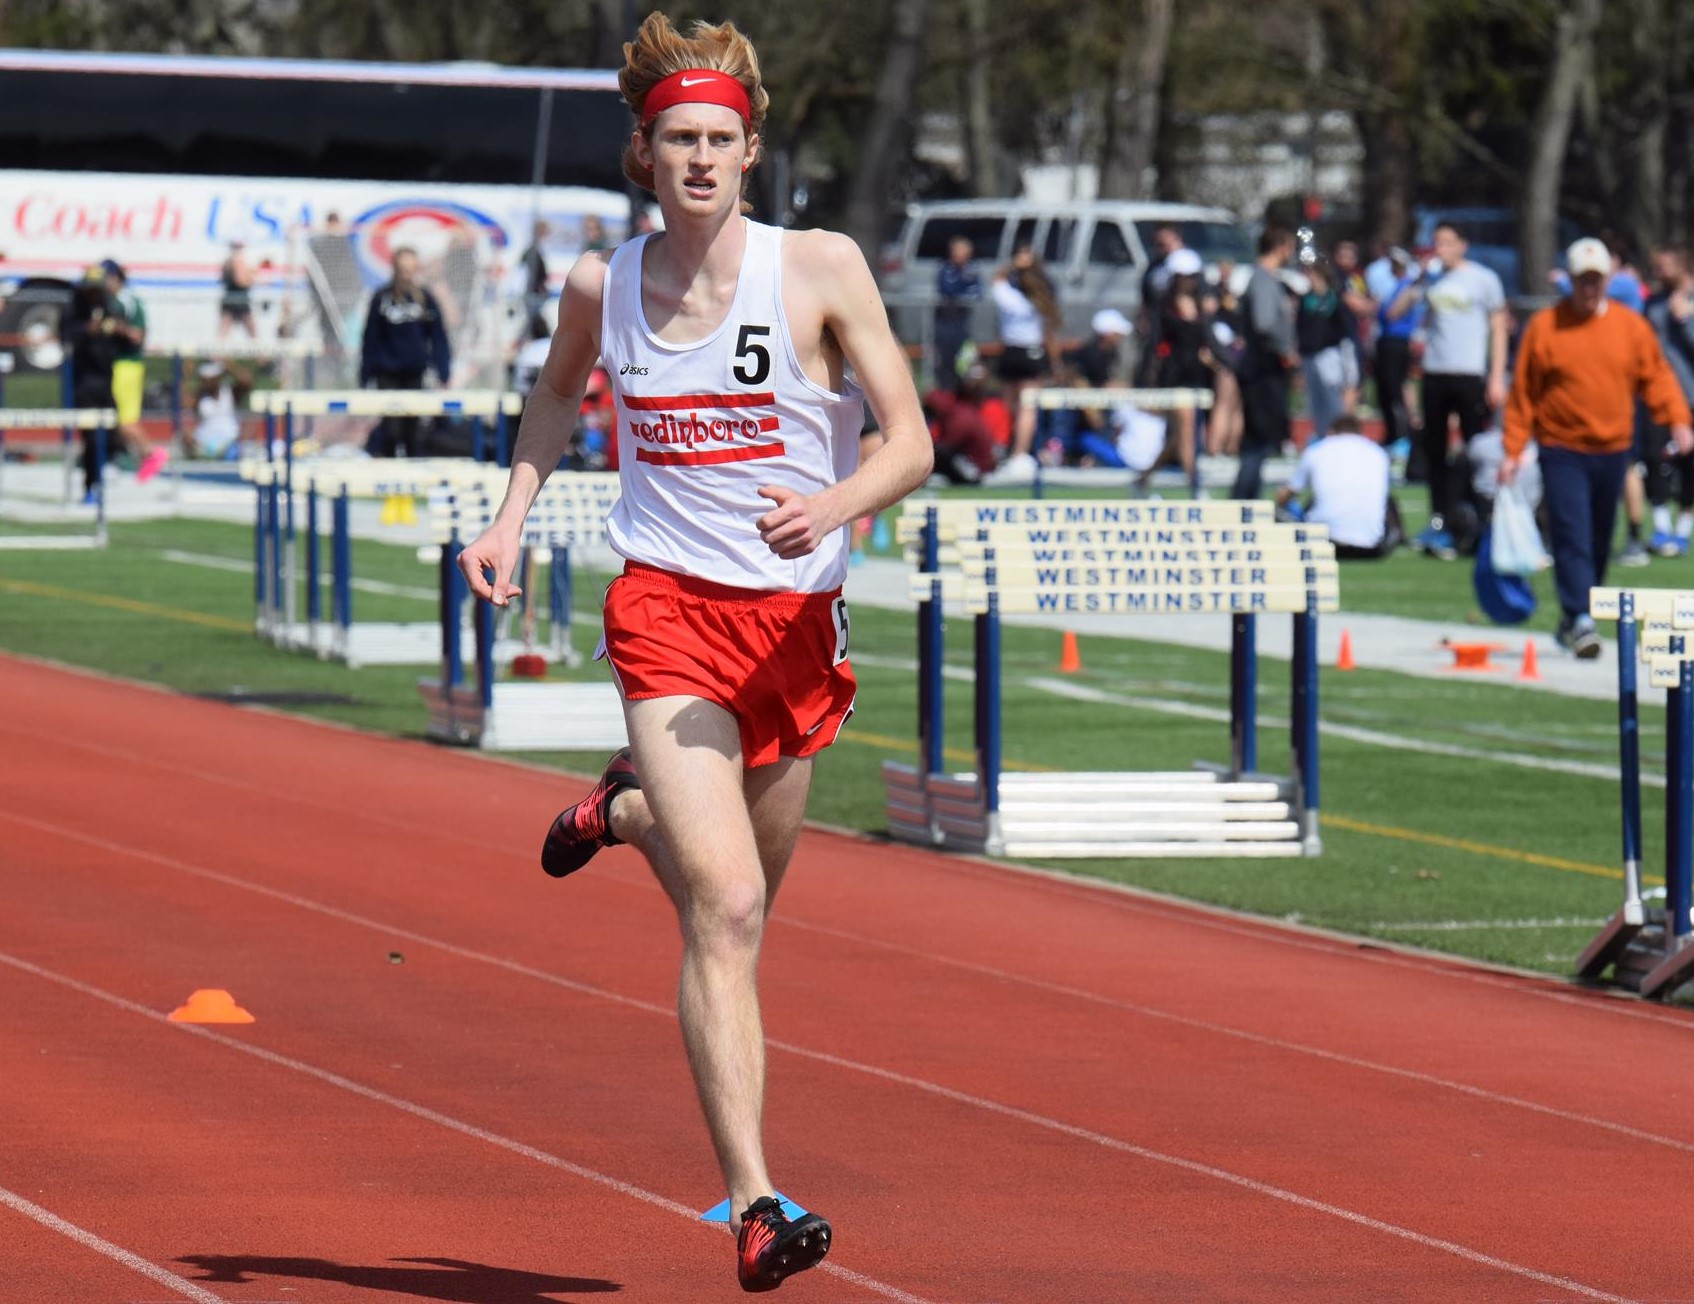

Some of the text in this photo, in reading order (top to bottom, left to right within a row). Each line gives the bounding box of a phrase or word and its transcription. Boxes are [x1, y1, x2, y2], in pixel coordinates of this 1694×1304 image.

[13, 195, 183, 241] Coach
[733, 324, 771, 386] 5
[639, 412, 758, 449] edinboro
[975, 506, 1204, 524] WESTMINSTER
[1027, 530, 1258, 544] WESTMINSTER
[1036, 567, 1268, 586] WESTMINSTER
[1036, 592, 1268, 612] WESTMINSTER
